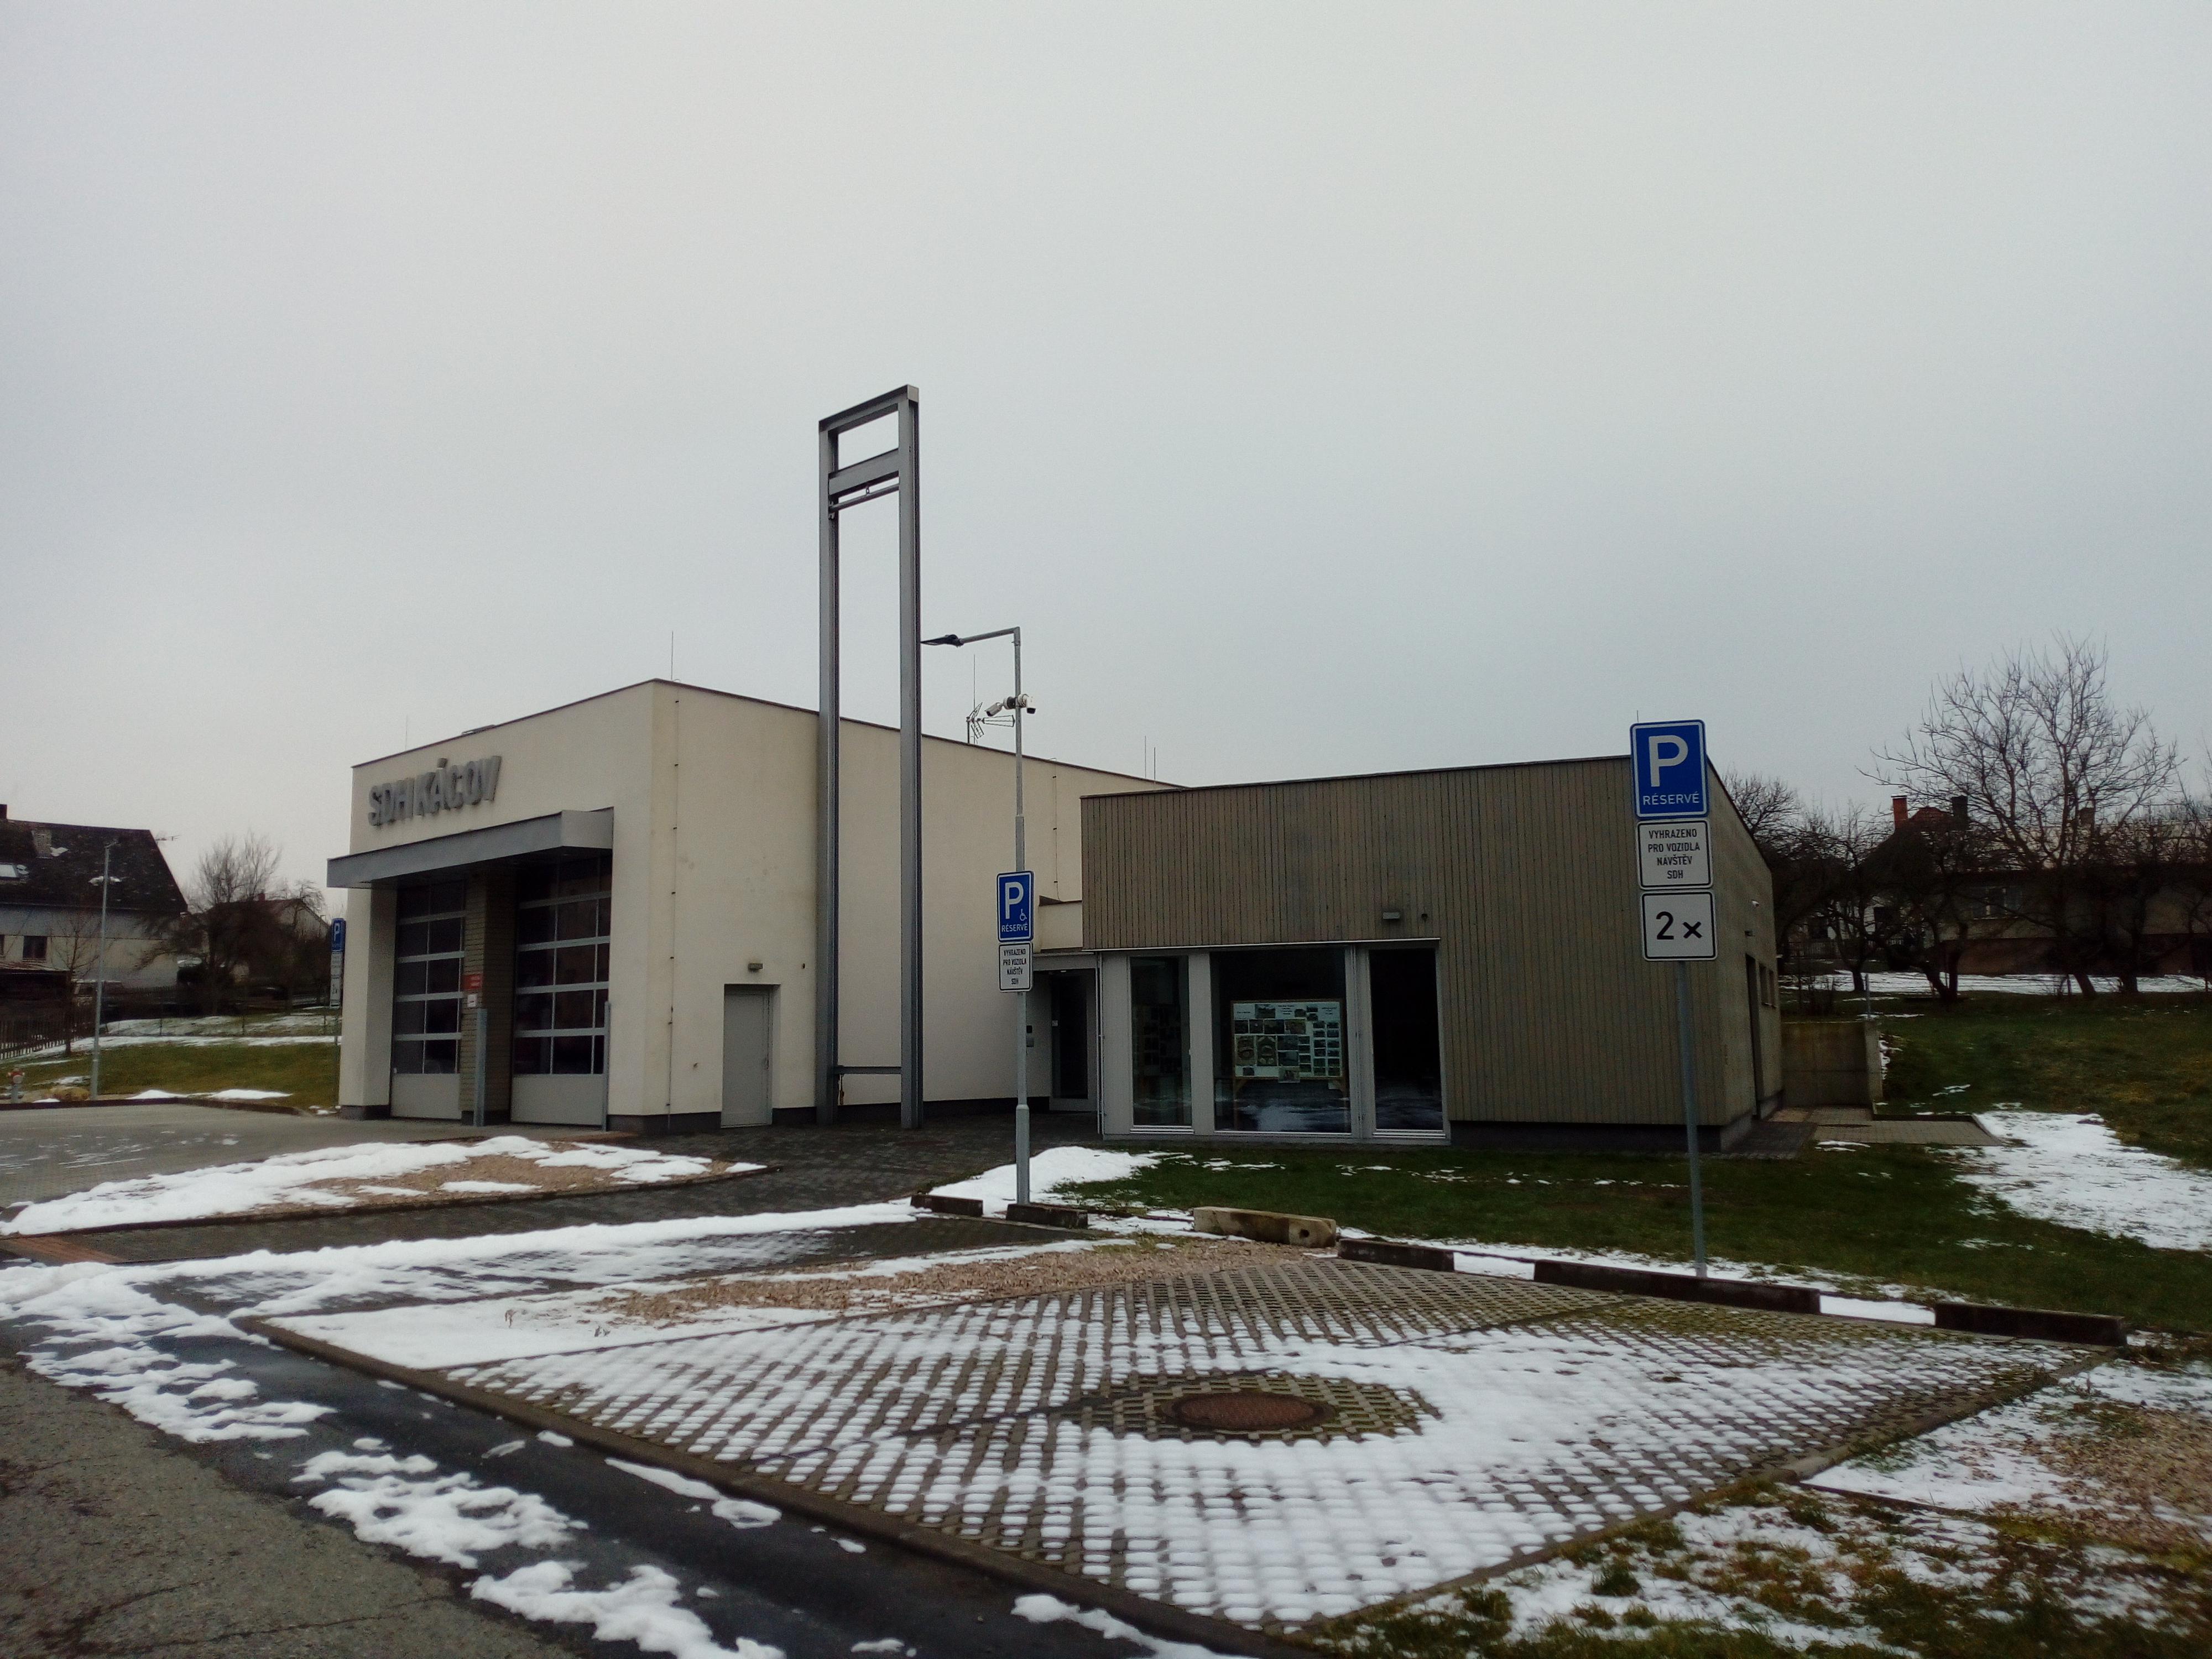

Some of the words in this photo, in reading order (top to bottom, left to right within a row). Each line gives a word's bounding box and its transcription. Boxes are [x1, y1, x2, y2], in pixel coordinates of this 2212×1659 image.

[1648, 735, 1688, 787] P
[1643, 791, 1700, 805] RÉSERVÉ
[1648, 829, 1697, 839] VYHRAZENO
[1648, 844, 1663, 852] PRO
[1667, 842, 1700, 852] VOZIDLA
[1657, 854, 1692, 866] NÁVŠTĚV
[1667, 870, 1683, 879] SDH
[1005, 881, 1024, 919] P
[1001, 922, 1028, 932] RÉSERVÉ
